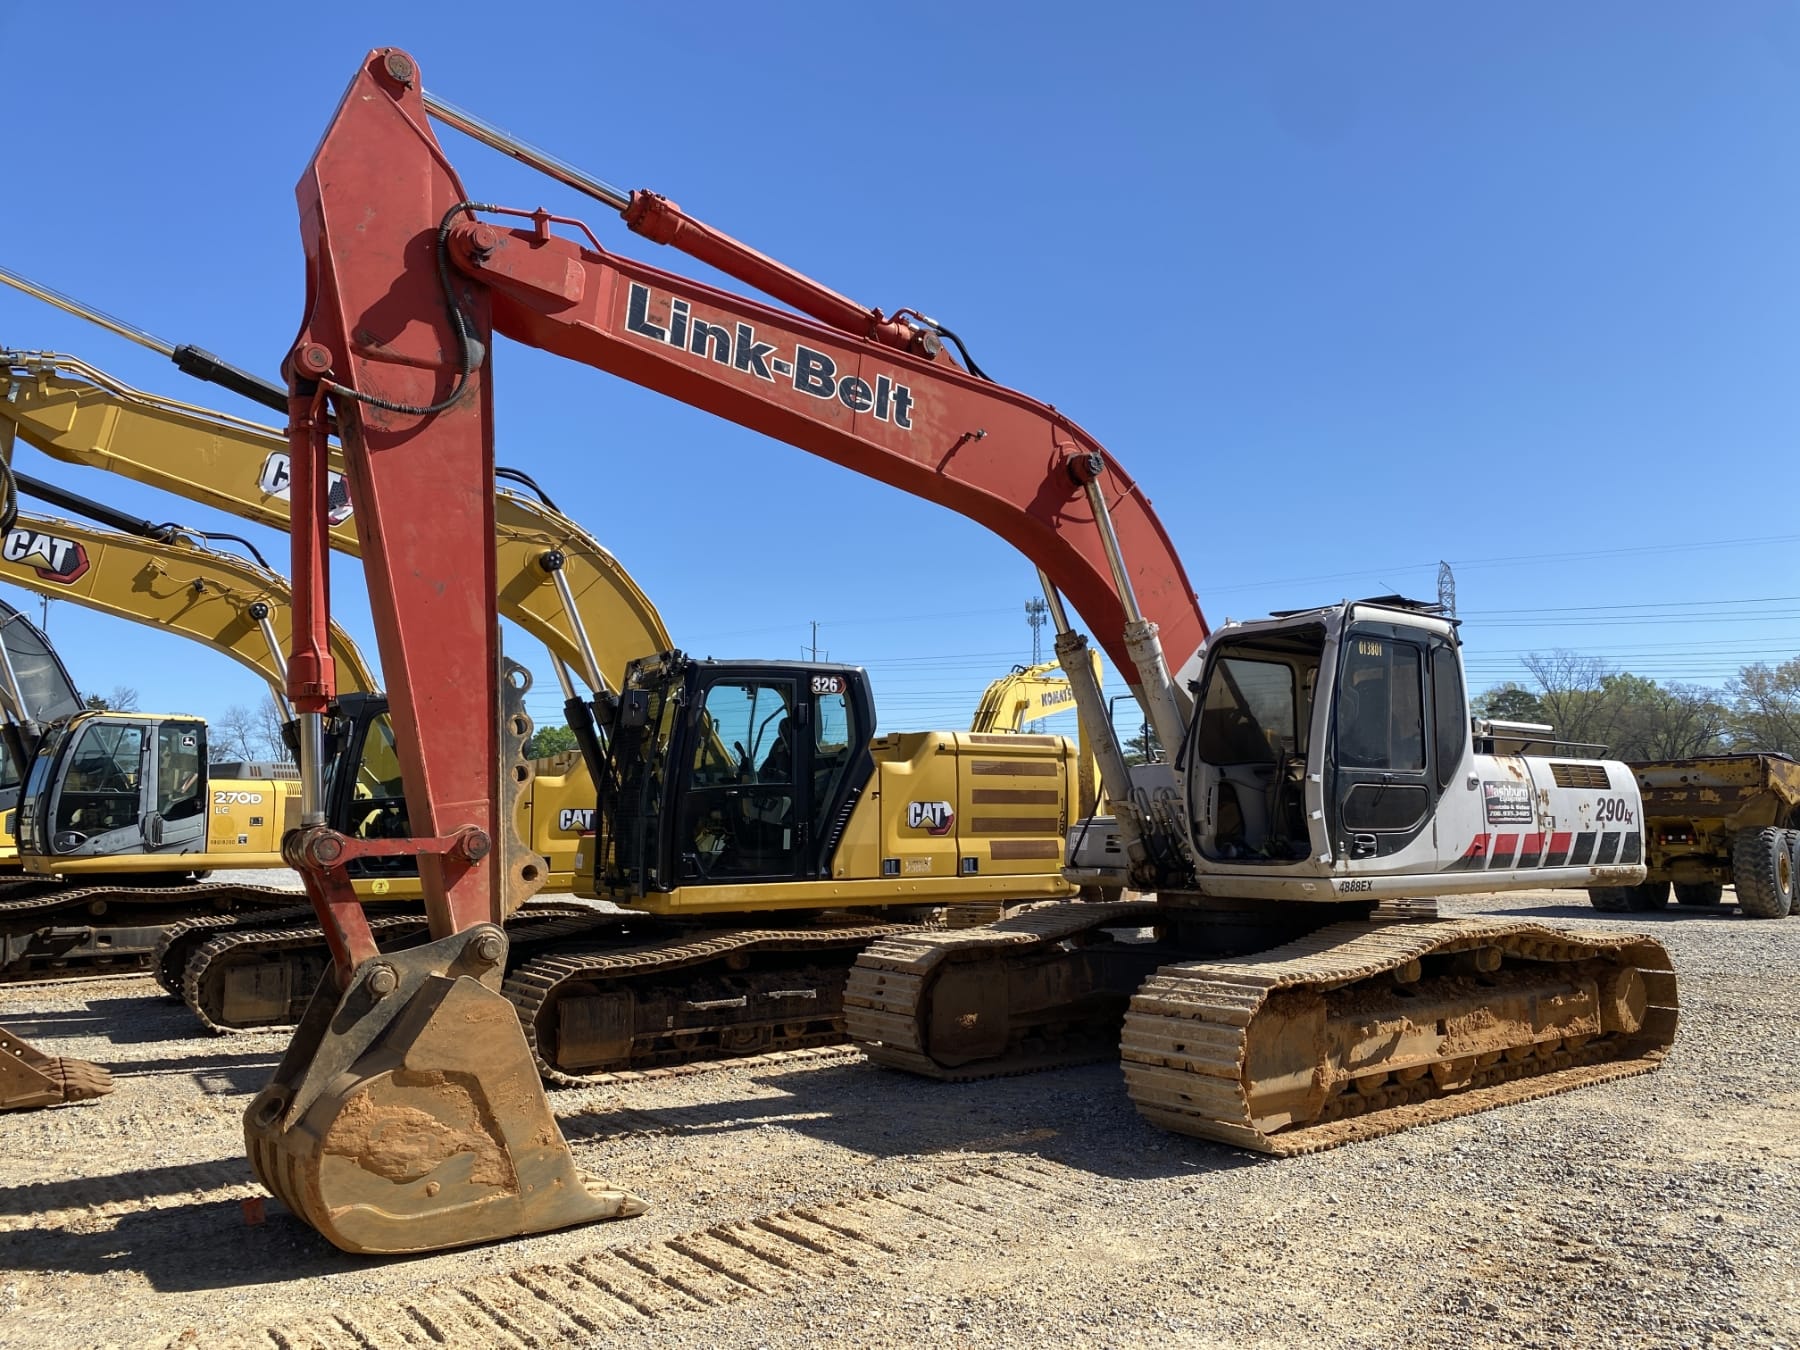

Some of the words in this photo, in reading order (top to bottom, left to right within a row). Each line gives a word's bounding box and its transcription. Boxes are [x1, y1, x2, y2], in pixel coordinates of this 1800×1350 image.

[623, 280, 915, 431] Link-Belt
[3, 529, 73, 572] CAT
[1358, 641, 1382, 656] 013801
[813, 677, 838, 693] 326
[1041, 687, 1072, 707] KOMATS
[214, 791, 262, 804] 270D
[214, 806, 230, 814] LC
[909, 802, 944, 827] CAT
[560, 809, 594, 830] CAT
[1339, 880, 1373, 893] 4888EX
